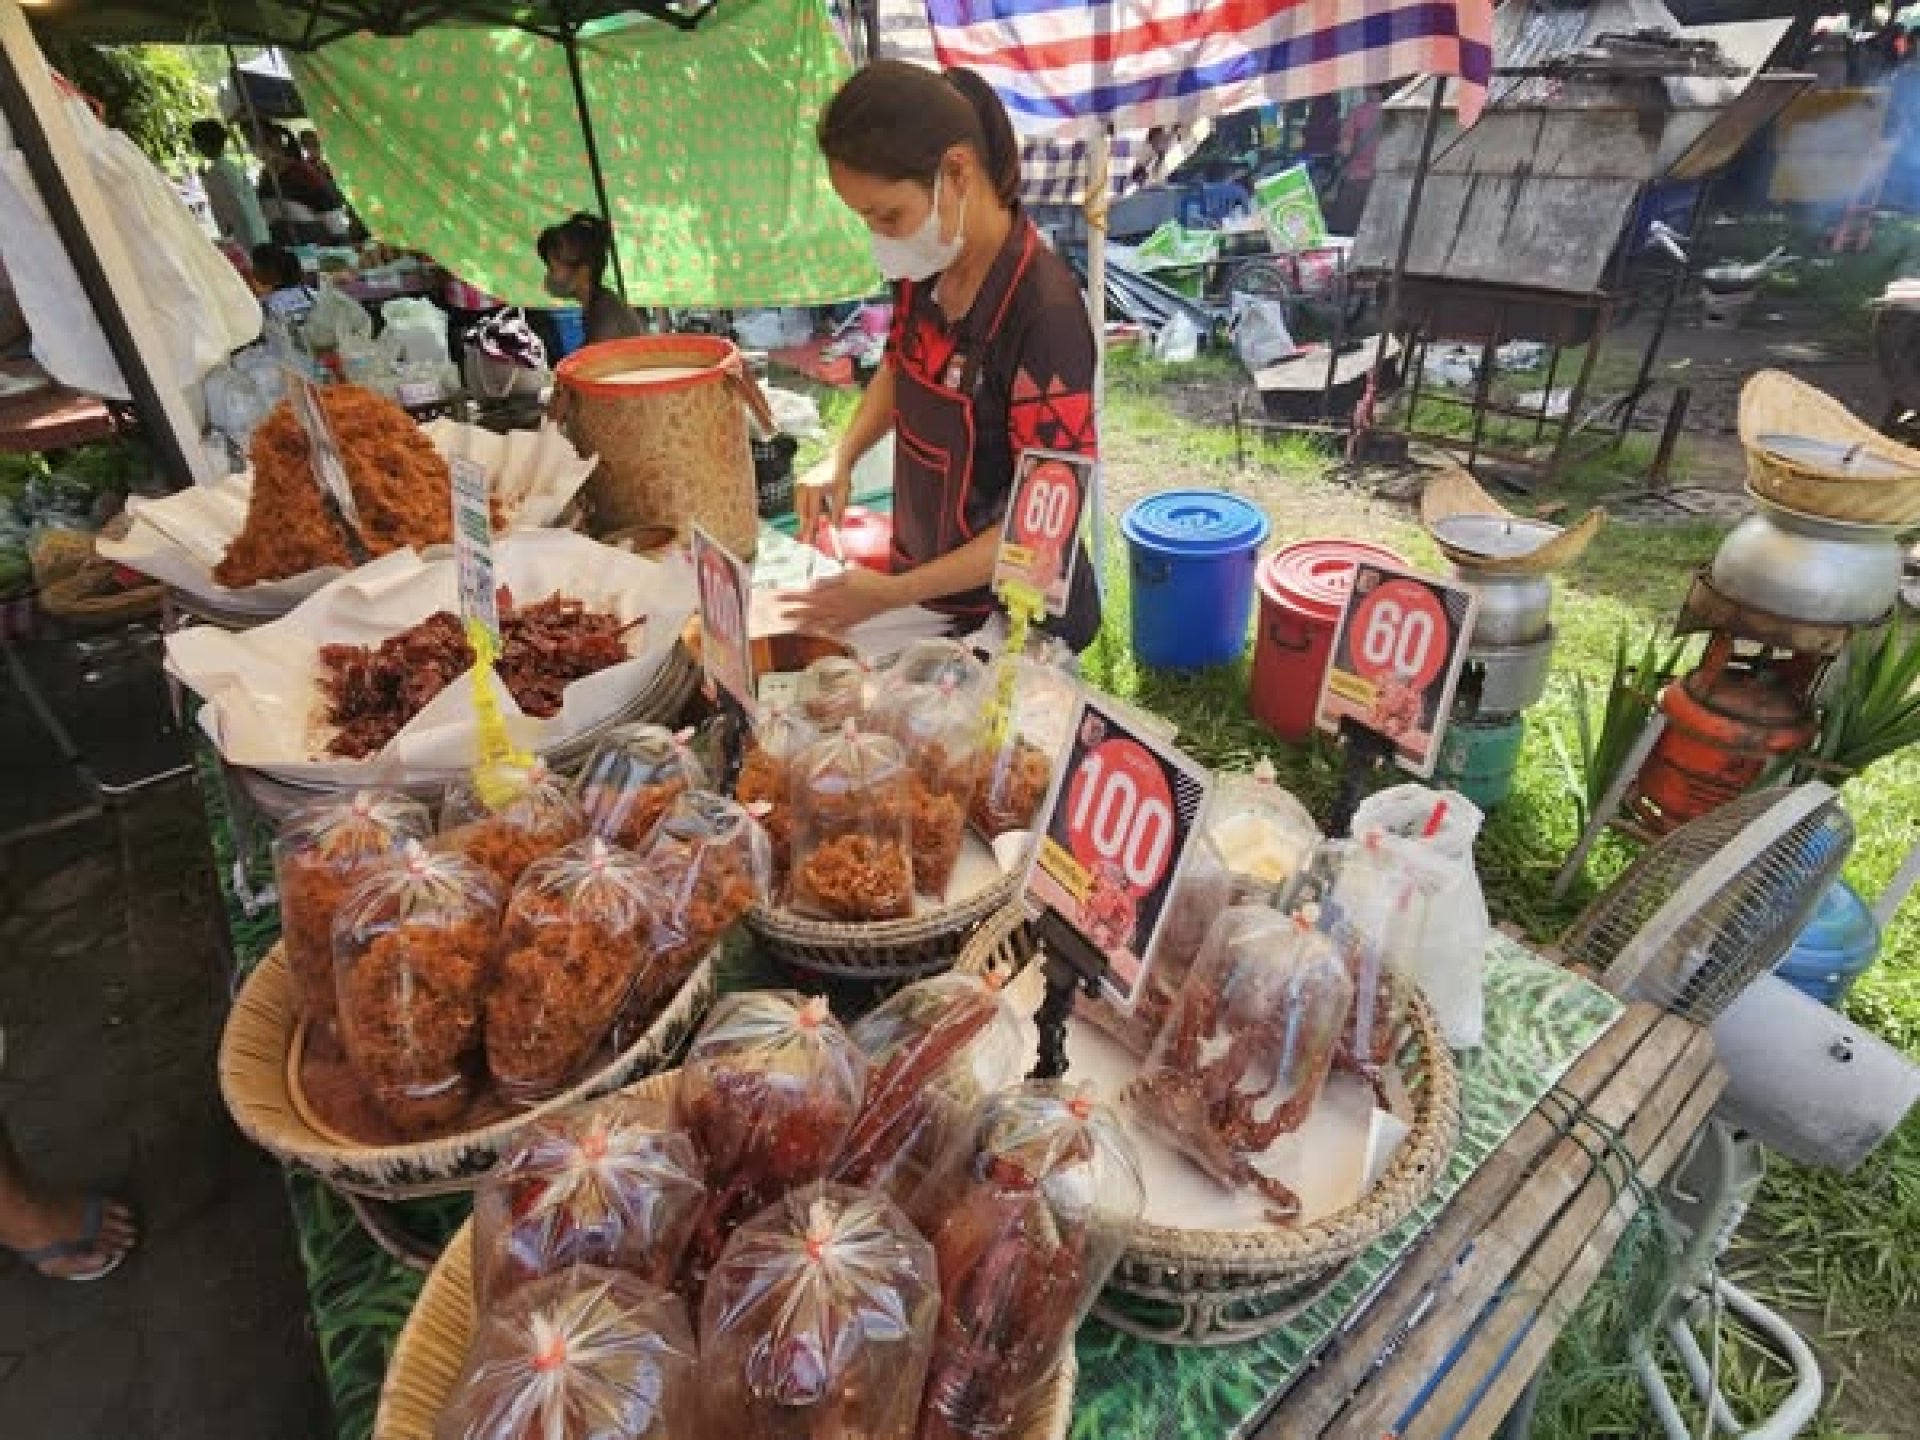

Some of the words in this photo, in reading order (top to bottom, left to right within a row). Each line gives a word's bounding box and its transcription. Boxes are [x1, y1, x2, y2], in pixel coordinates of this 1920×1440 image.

[1024, 480, 1070, 538] 60
[1363, 600, 1435, 678] 60
[1071, 753, 1174, 887] 100
